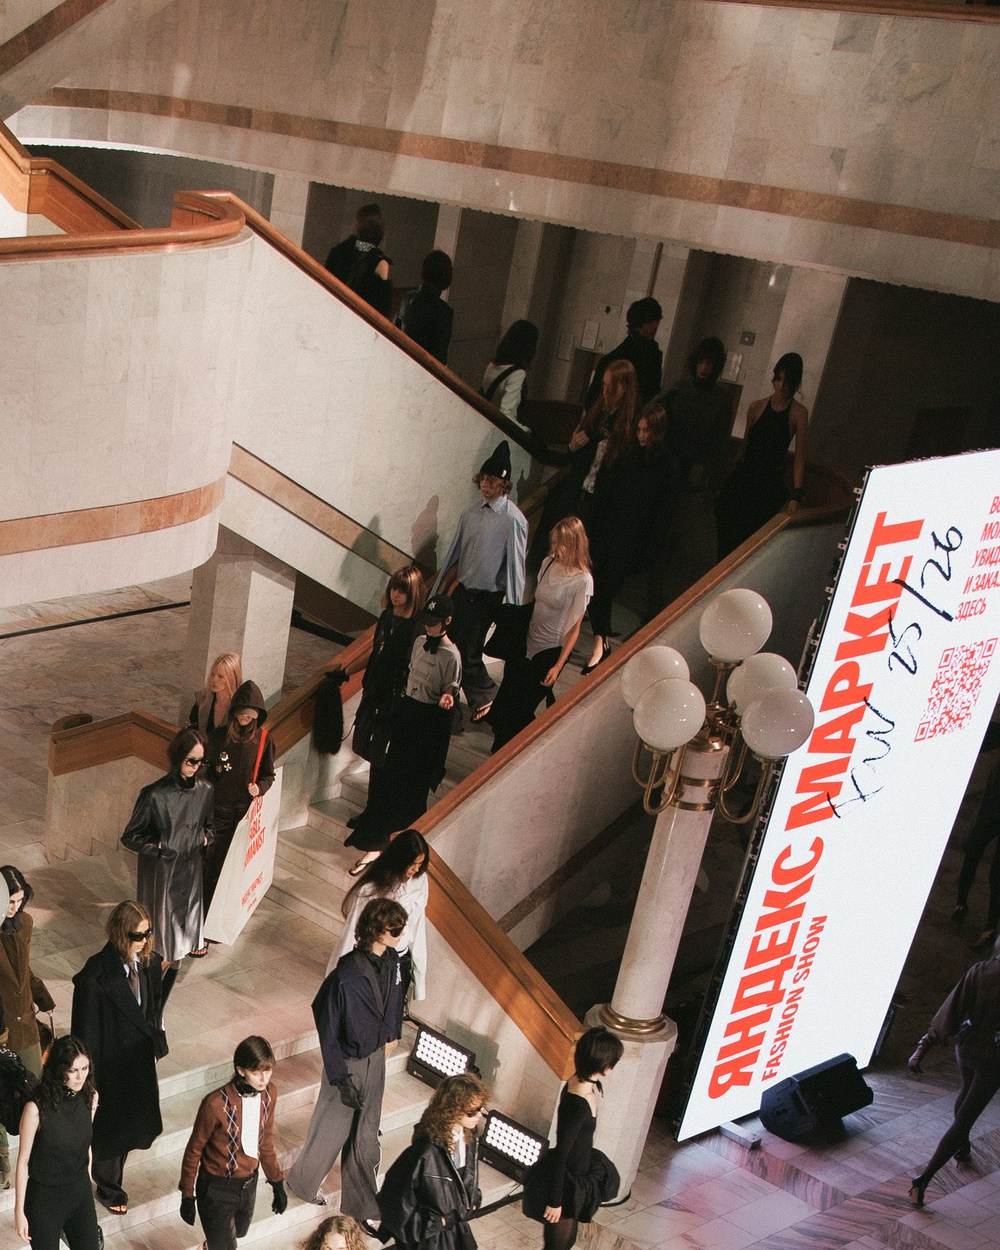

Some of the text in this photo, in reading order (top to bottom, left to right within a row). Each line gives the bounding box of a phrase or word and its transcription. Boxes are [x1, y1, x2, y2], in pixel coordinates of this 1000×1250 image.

[972, 545, 1000, 569] УВИД
[962, 570, 1000, 594] И ЗАКА
[954, 597, 988, 622] ЗДЕСЬ
[707, 511, 925, 1100] ЯНДЕКС МАРКЕТ
[761, 914, 828, 1083] FASHION SHOW
